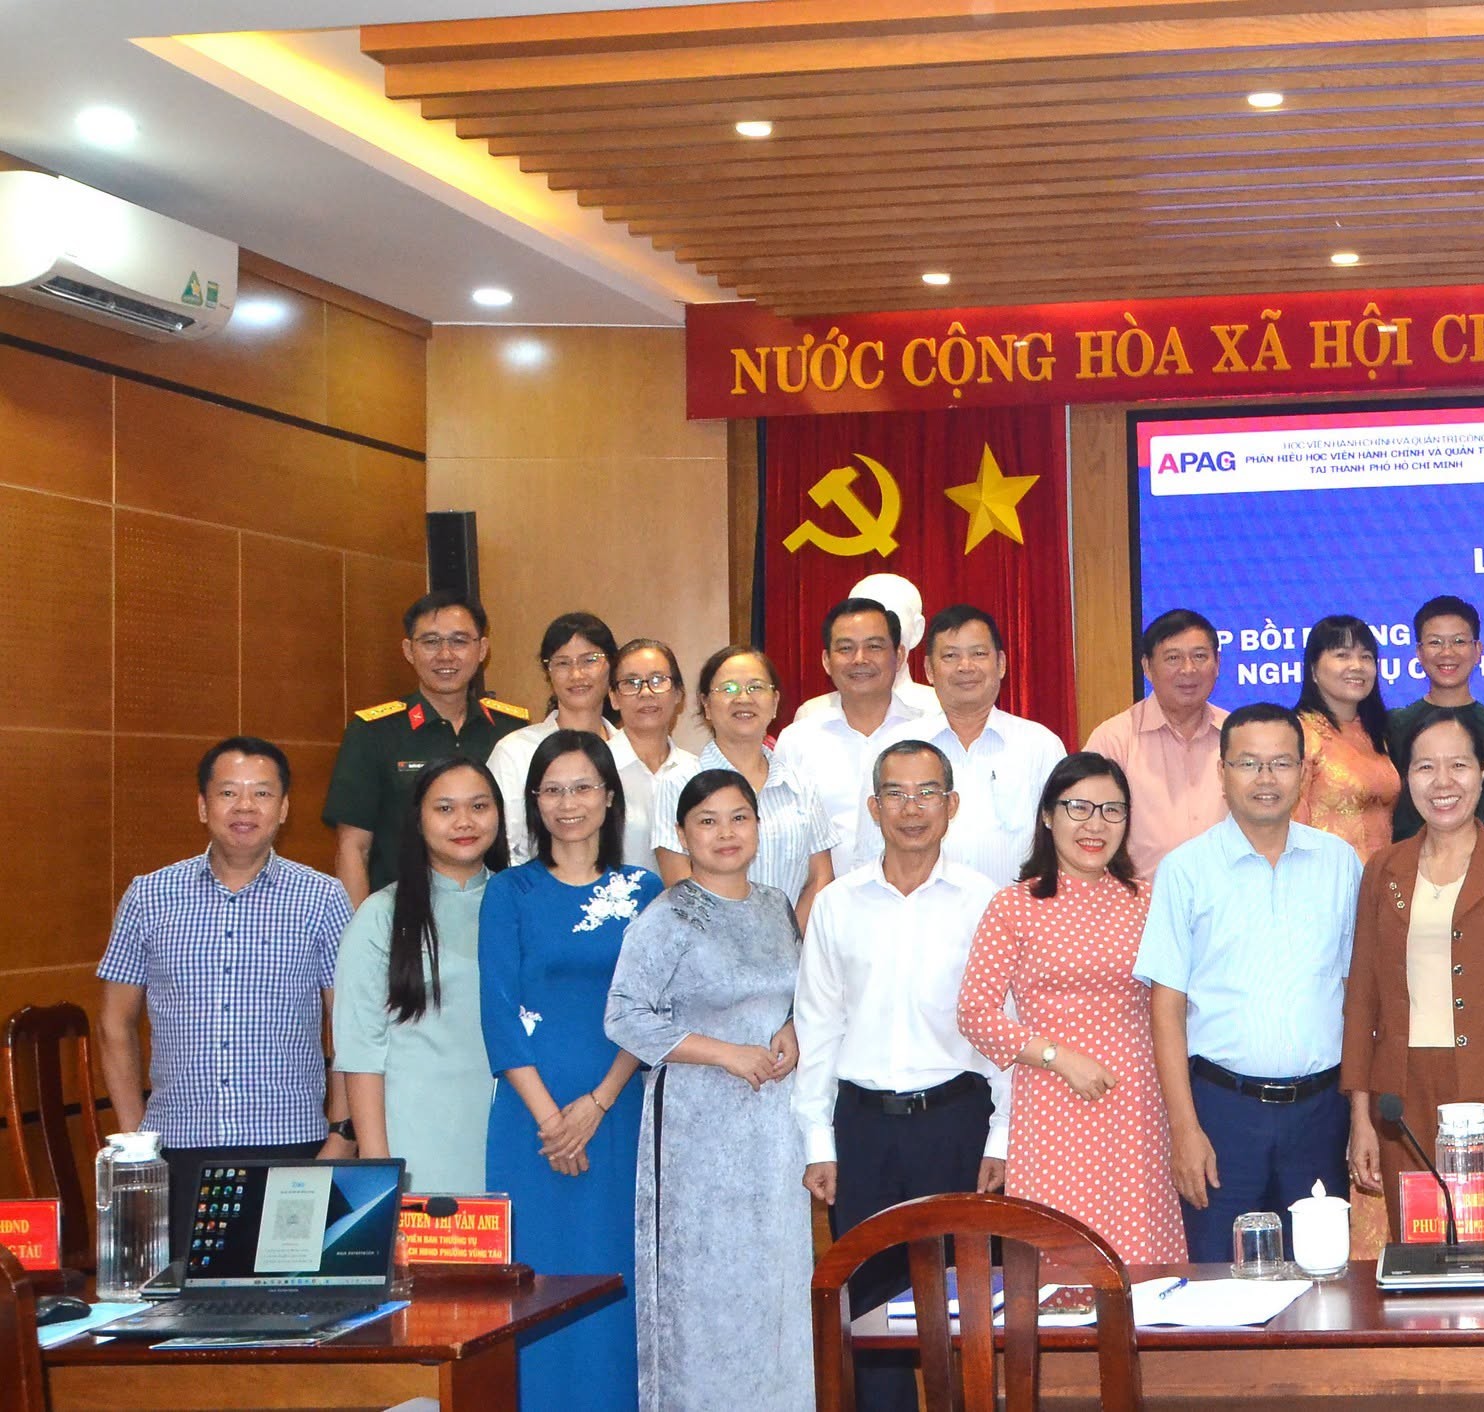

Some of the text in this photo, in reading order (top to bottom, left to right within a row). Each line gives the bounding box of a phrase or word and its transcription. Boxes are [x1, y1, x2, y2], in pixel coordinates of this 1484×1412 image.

[730, 327, 885, 395] NƯỚC
[902, 321, 1056, 399] CỘNG
[1075, 312, 1194, 378] HÒA
[1210, 308, 1292, 374] XÃ
[1309, 302, 1414, 381] HỘI
[1158, 451, 1236, 474] APAG
[1433, 460, 1463, 469] MINH
[1240, 618, 1295, 651] BỒI
[1238, 661, 1302, 685] NGH
[477, 1214, 500, 1231] ANH
